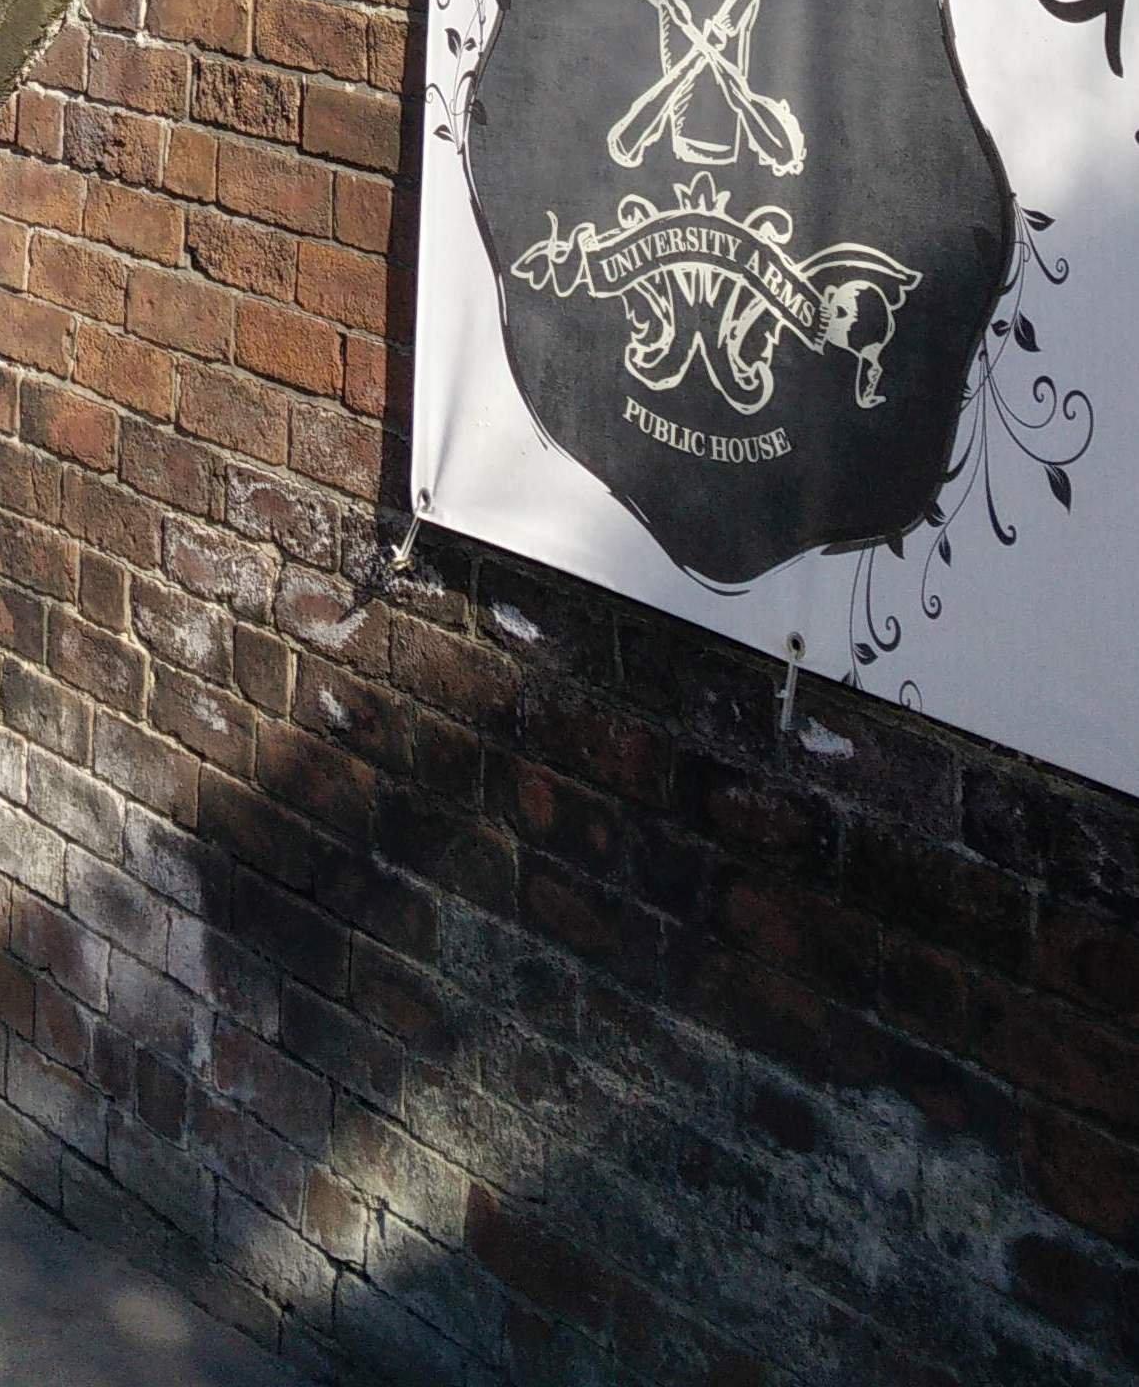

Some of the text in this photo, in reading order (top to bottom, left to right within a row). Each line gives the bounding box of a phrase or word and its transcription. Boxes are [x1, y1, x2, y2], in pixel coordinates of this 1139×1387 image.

[599, 226, 816, 328] UNIVERSITY ARMS
[622, 395, 793, 464] PUBLIC HOUSE
